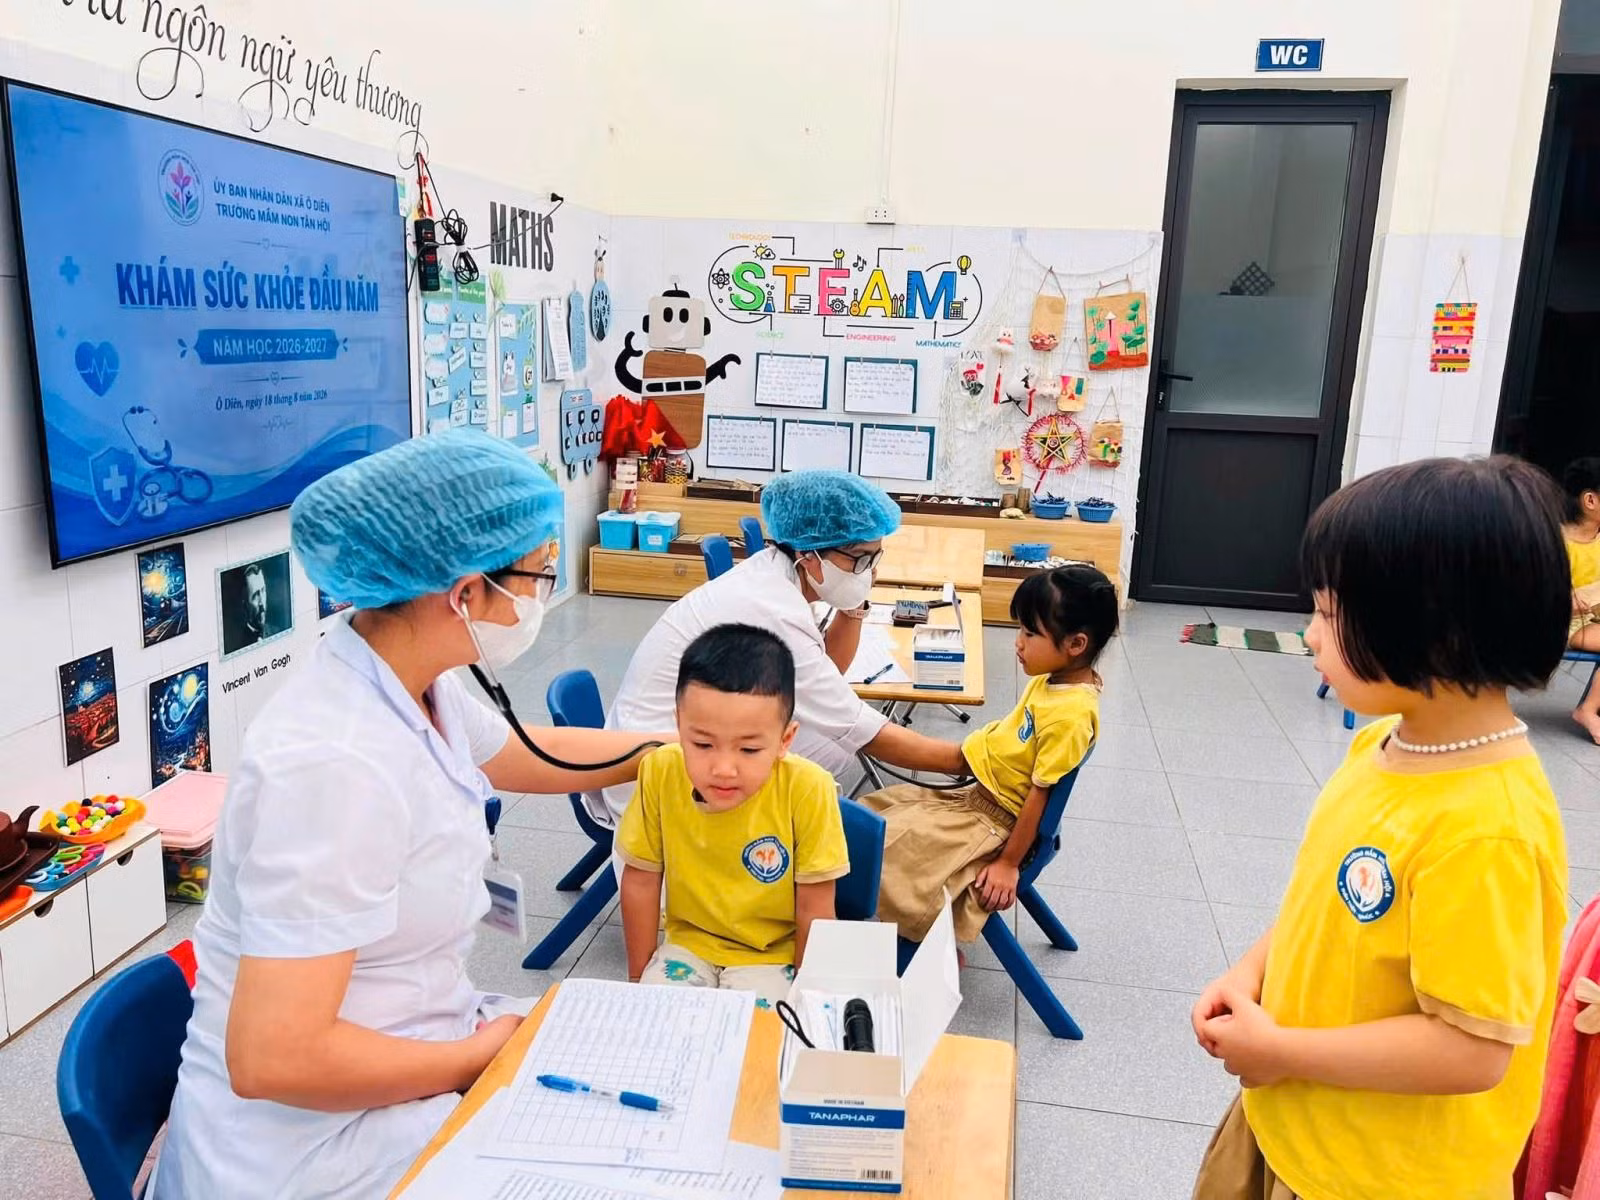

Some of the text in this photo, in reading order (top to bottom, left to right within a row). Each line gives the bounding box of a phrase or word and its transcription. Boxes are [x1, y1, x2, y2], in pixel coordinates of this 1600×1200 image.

[1270, 44, 1308, 65] WC
[294, 56, 347, 126] yêu
[356, 49, 429, 170] thương
[229, 183, 247, 199] BAN
[249, 186, 274, 204] NHÂN
[275, 190, 293, 207] DÂN
[294, 194, 305, 209] XÃ
[306, 195, 312, 210] Ô
[313, 197, 331, 213] DIÊN
[215, 201, 256, 221] TRƯỜNG
[281, 214, 299, 228] NON
[300, 214, 316, 230] TÂN
[317, 217, 331, 234] HỘI
[489, 200, 554, 272] MATHS
[116, 256, 379, 312] KHÁM SỨC KHỎE ĐẦU NĂM
[730, 262, 957, 320] STEAM
[213, 336, 327, 361] NĂM HỌC 2026-2027
[846, 333, 896, 342] ENGINEERING
[216, 396, 222, 410] Ô
[245, 394, 263, 410] ngày
[264, 394, 272, 405] 18
[222, 654, 291, 694] Vincent Van Gogh
[808, 1112, 875, 1122] TANAPHAR
